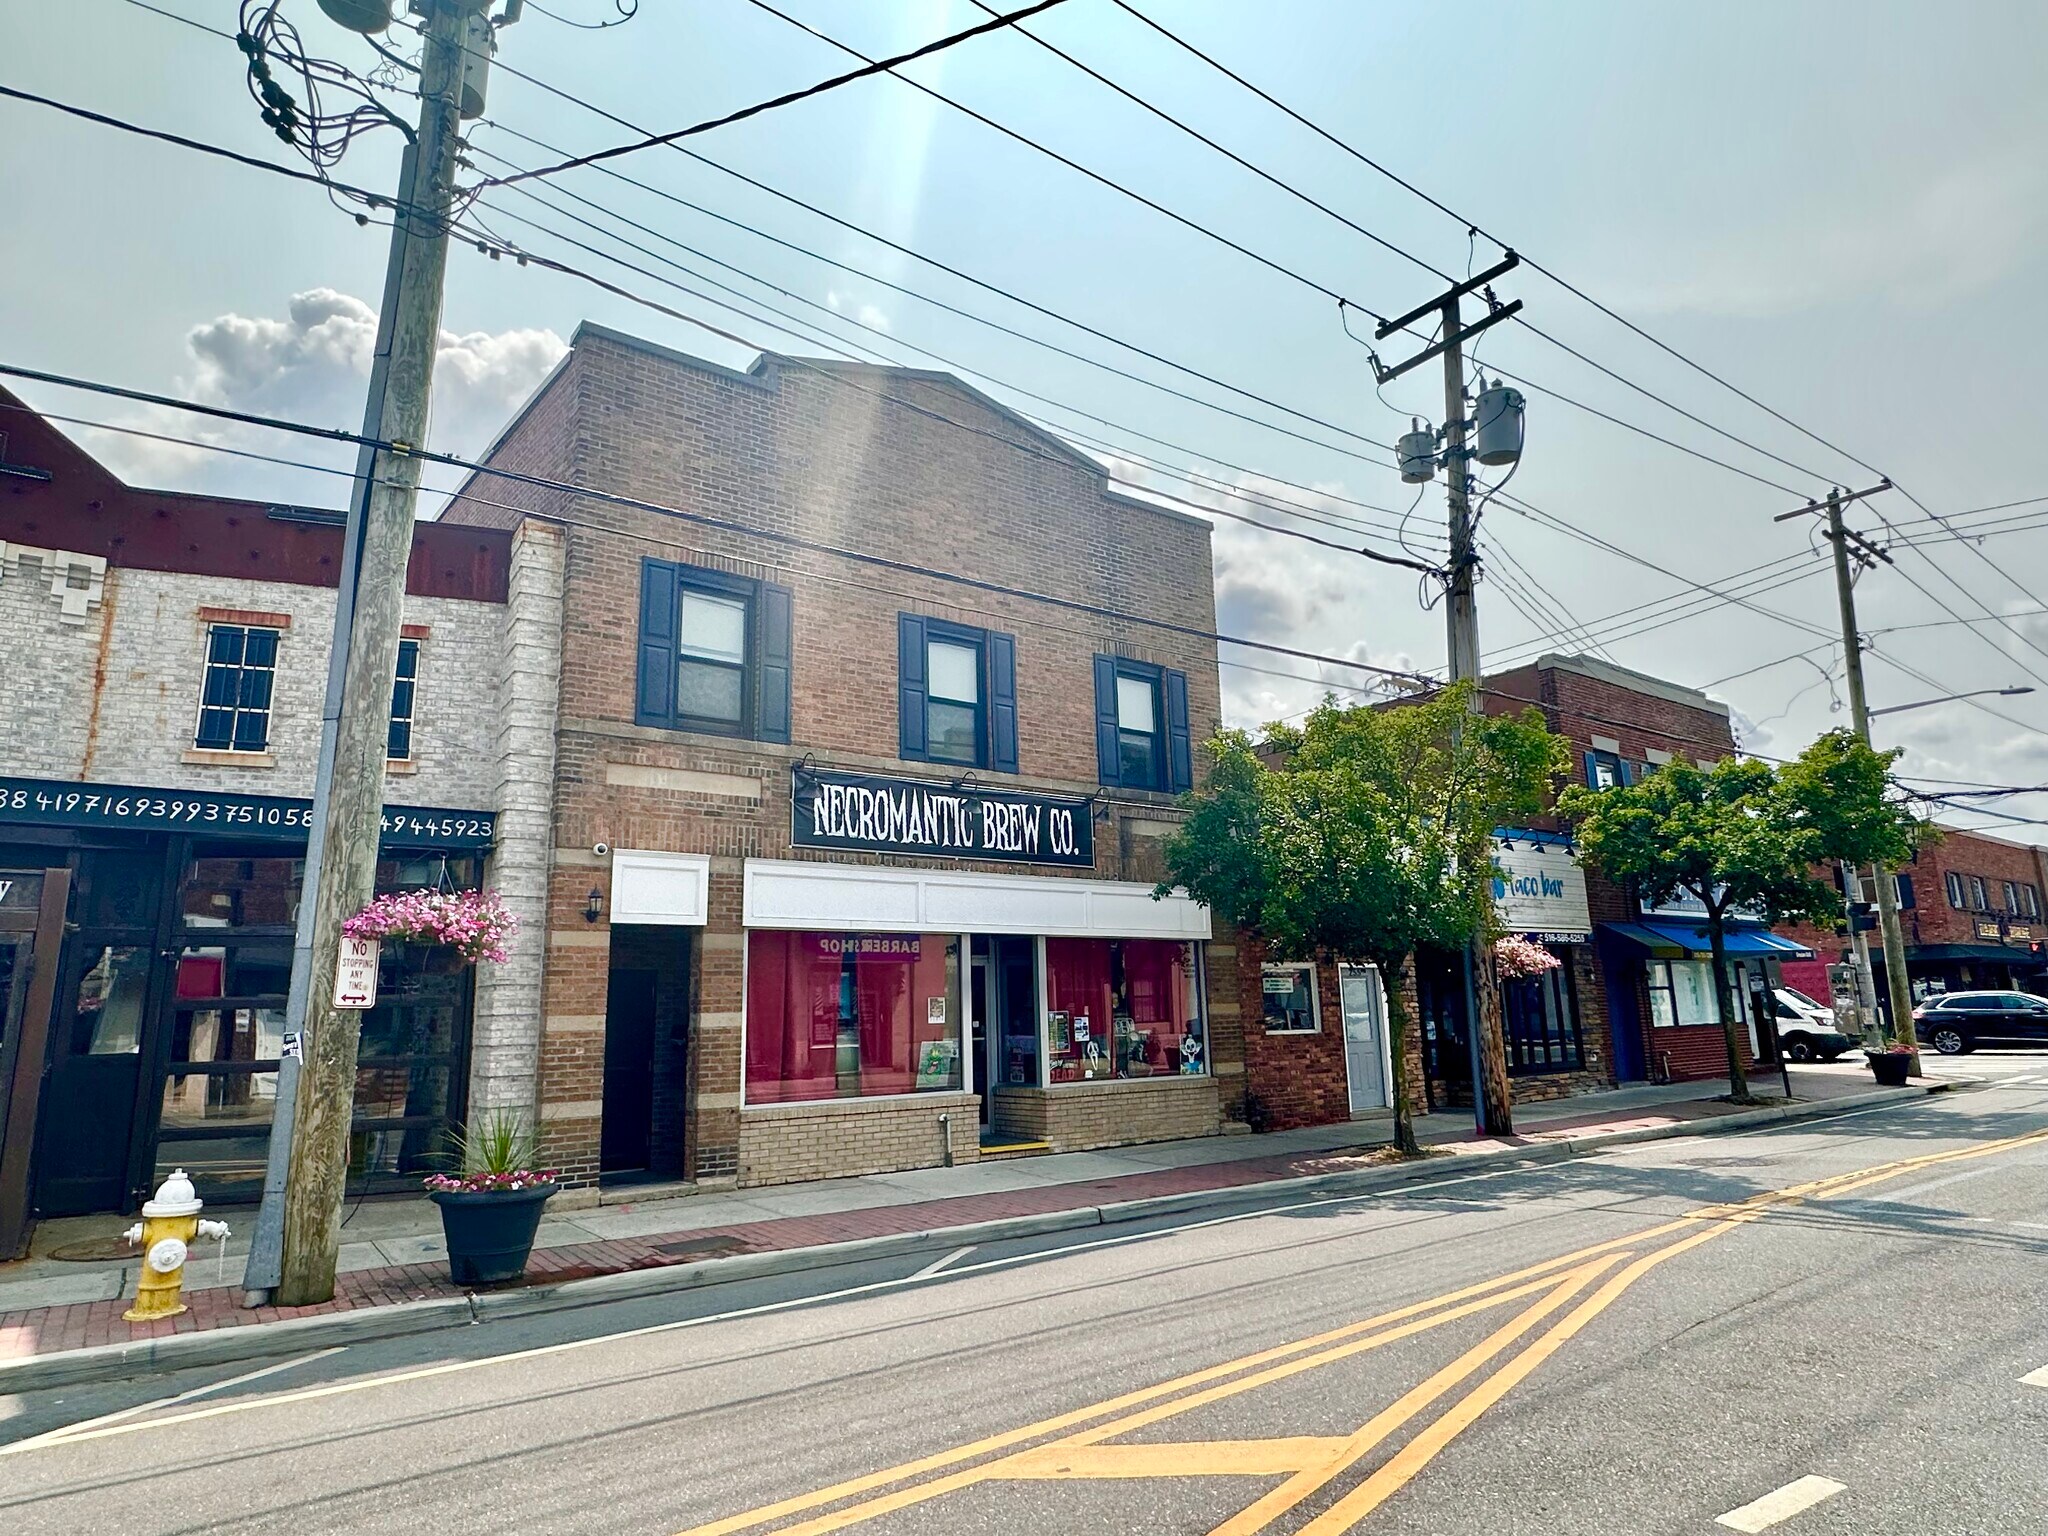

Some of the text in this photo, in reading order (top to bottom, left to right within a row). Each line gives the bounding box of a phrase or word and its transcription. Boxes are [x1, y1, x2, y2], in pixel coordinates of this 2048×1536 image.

[813, 783, 1080, 856] NECROMANTIC BREW CO.
[1506, 867, 1564, 898] taco bar
[351, 942, 368, 956] NO
[342, 958, 374, 969] STOPPING
[350, 970, 363, 979] ANY
[348, 981, 363, 991] TIME
